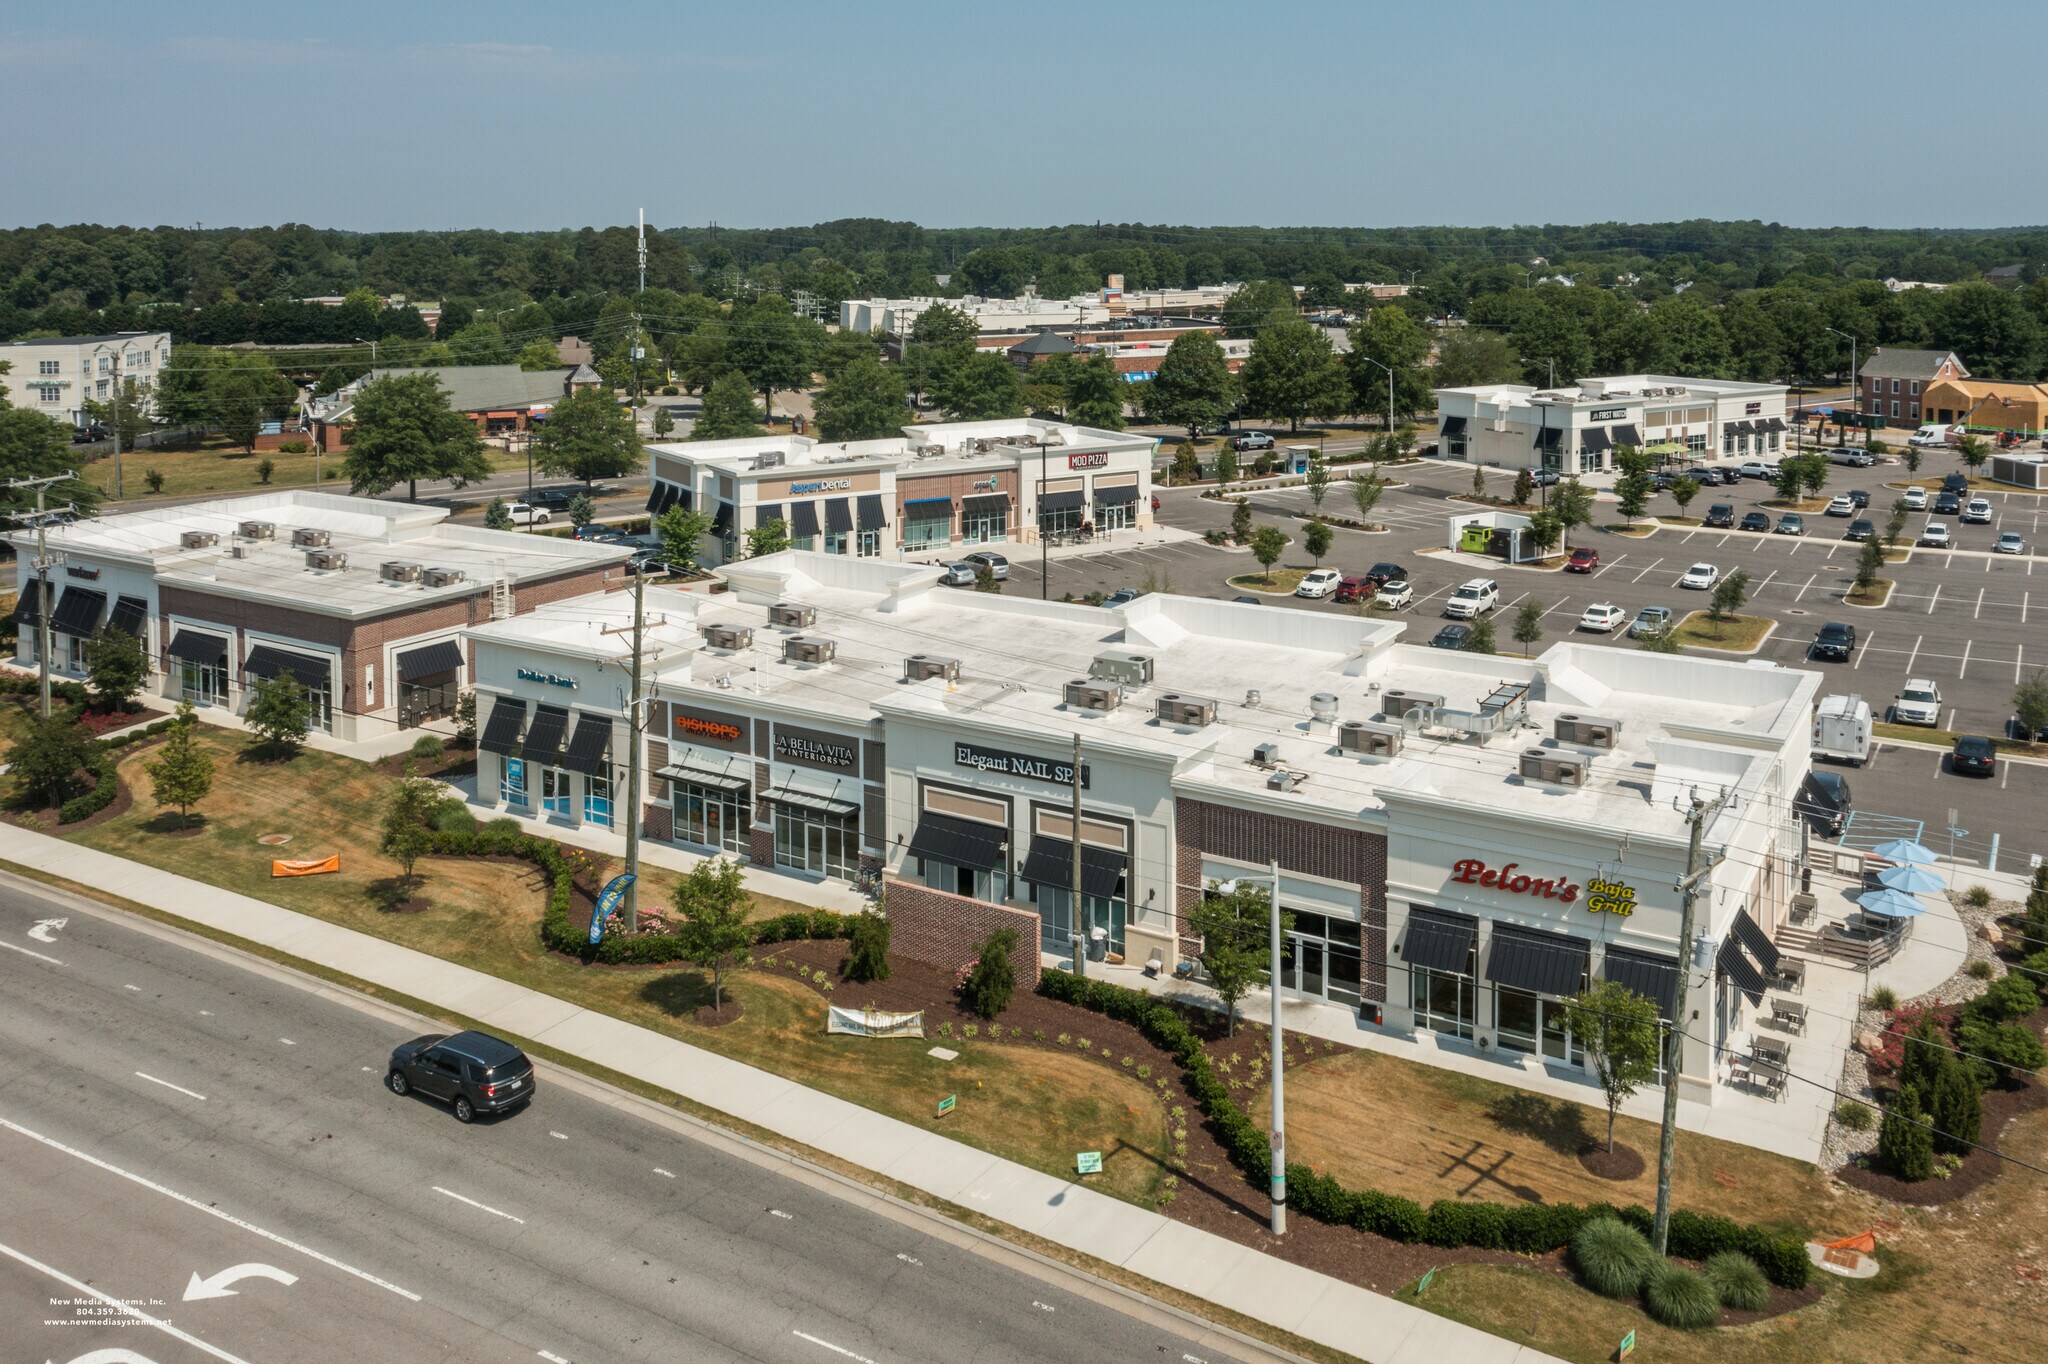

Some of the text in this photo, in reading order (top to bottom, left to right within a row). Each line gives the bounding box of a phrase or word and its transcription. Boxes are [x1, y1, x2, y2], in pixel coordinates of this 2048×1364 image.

[1071, 454, 1107, 467] MOD PIZZA
[517, 667, 578, 689] Dollar Bank
[675, 715, 742, 740] BISHOPS
[773, 734, 853, 760] LA BELLA VITA
[788, 748, 838, 765] INTERIORS
[957, 747, 1009, 771] Elegant
[1011, 757, 1053, 779] NAIL
[1451, 858, 1580, 903] Pelon's
[1587, 878, 1636, 899] Baja
[1587, 896, 1637, 917] Grill
[868, 1013, 920, 1028] NOW OPEN
